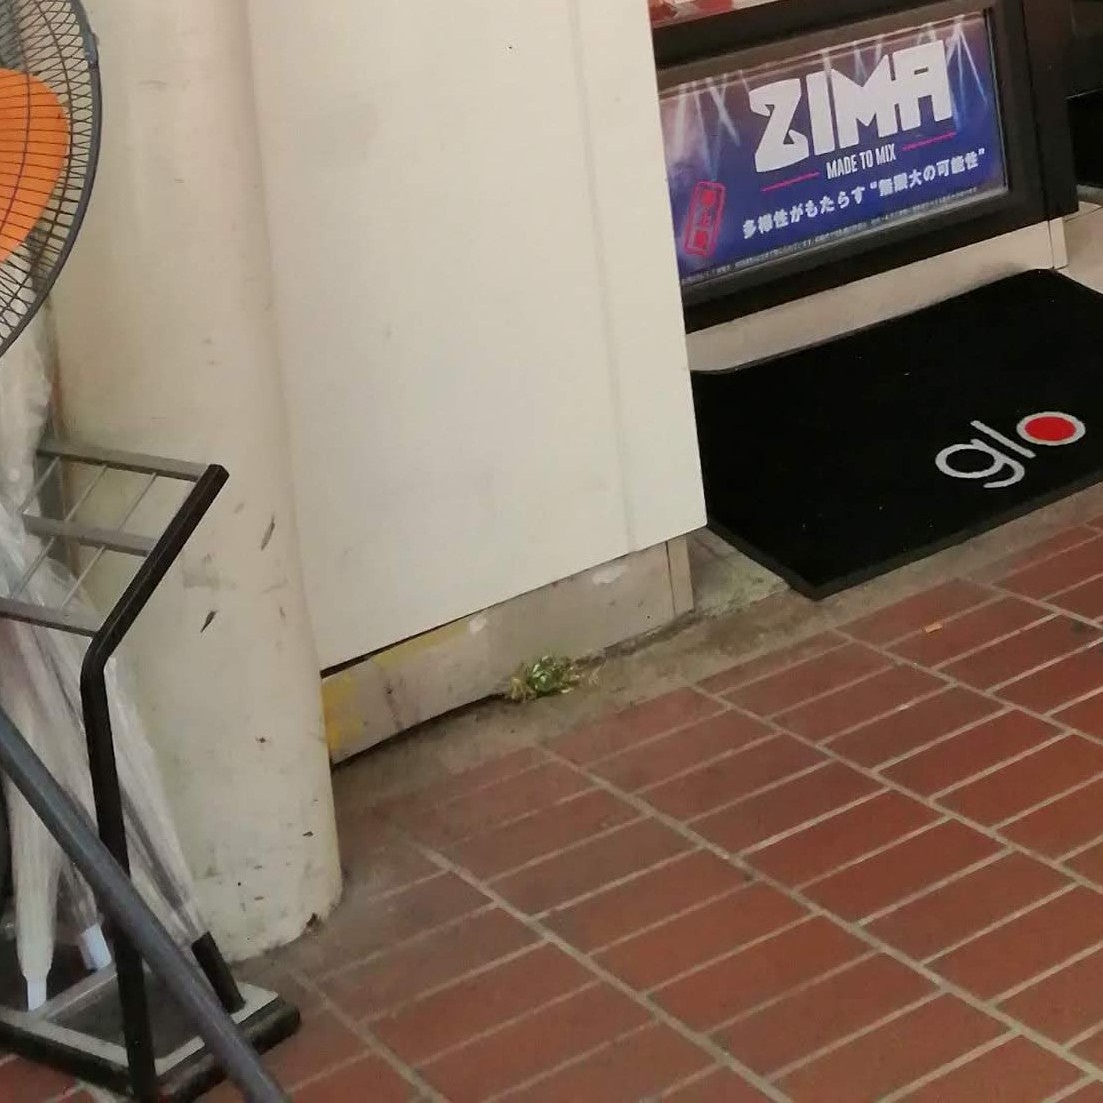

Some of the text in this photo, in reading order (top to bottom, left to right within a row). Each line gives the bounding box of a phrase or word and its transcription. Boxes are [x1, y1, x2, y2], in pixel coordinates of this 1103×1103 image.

[748, 39, 955, 173] ZIMA
[826, 143, 897, 180] MADE TO MIX
[934, 410, 1086, 489] glo
